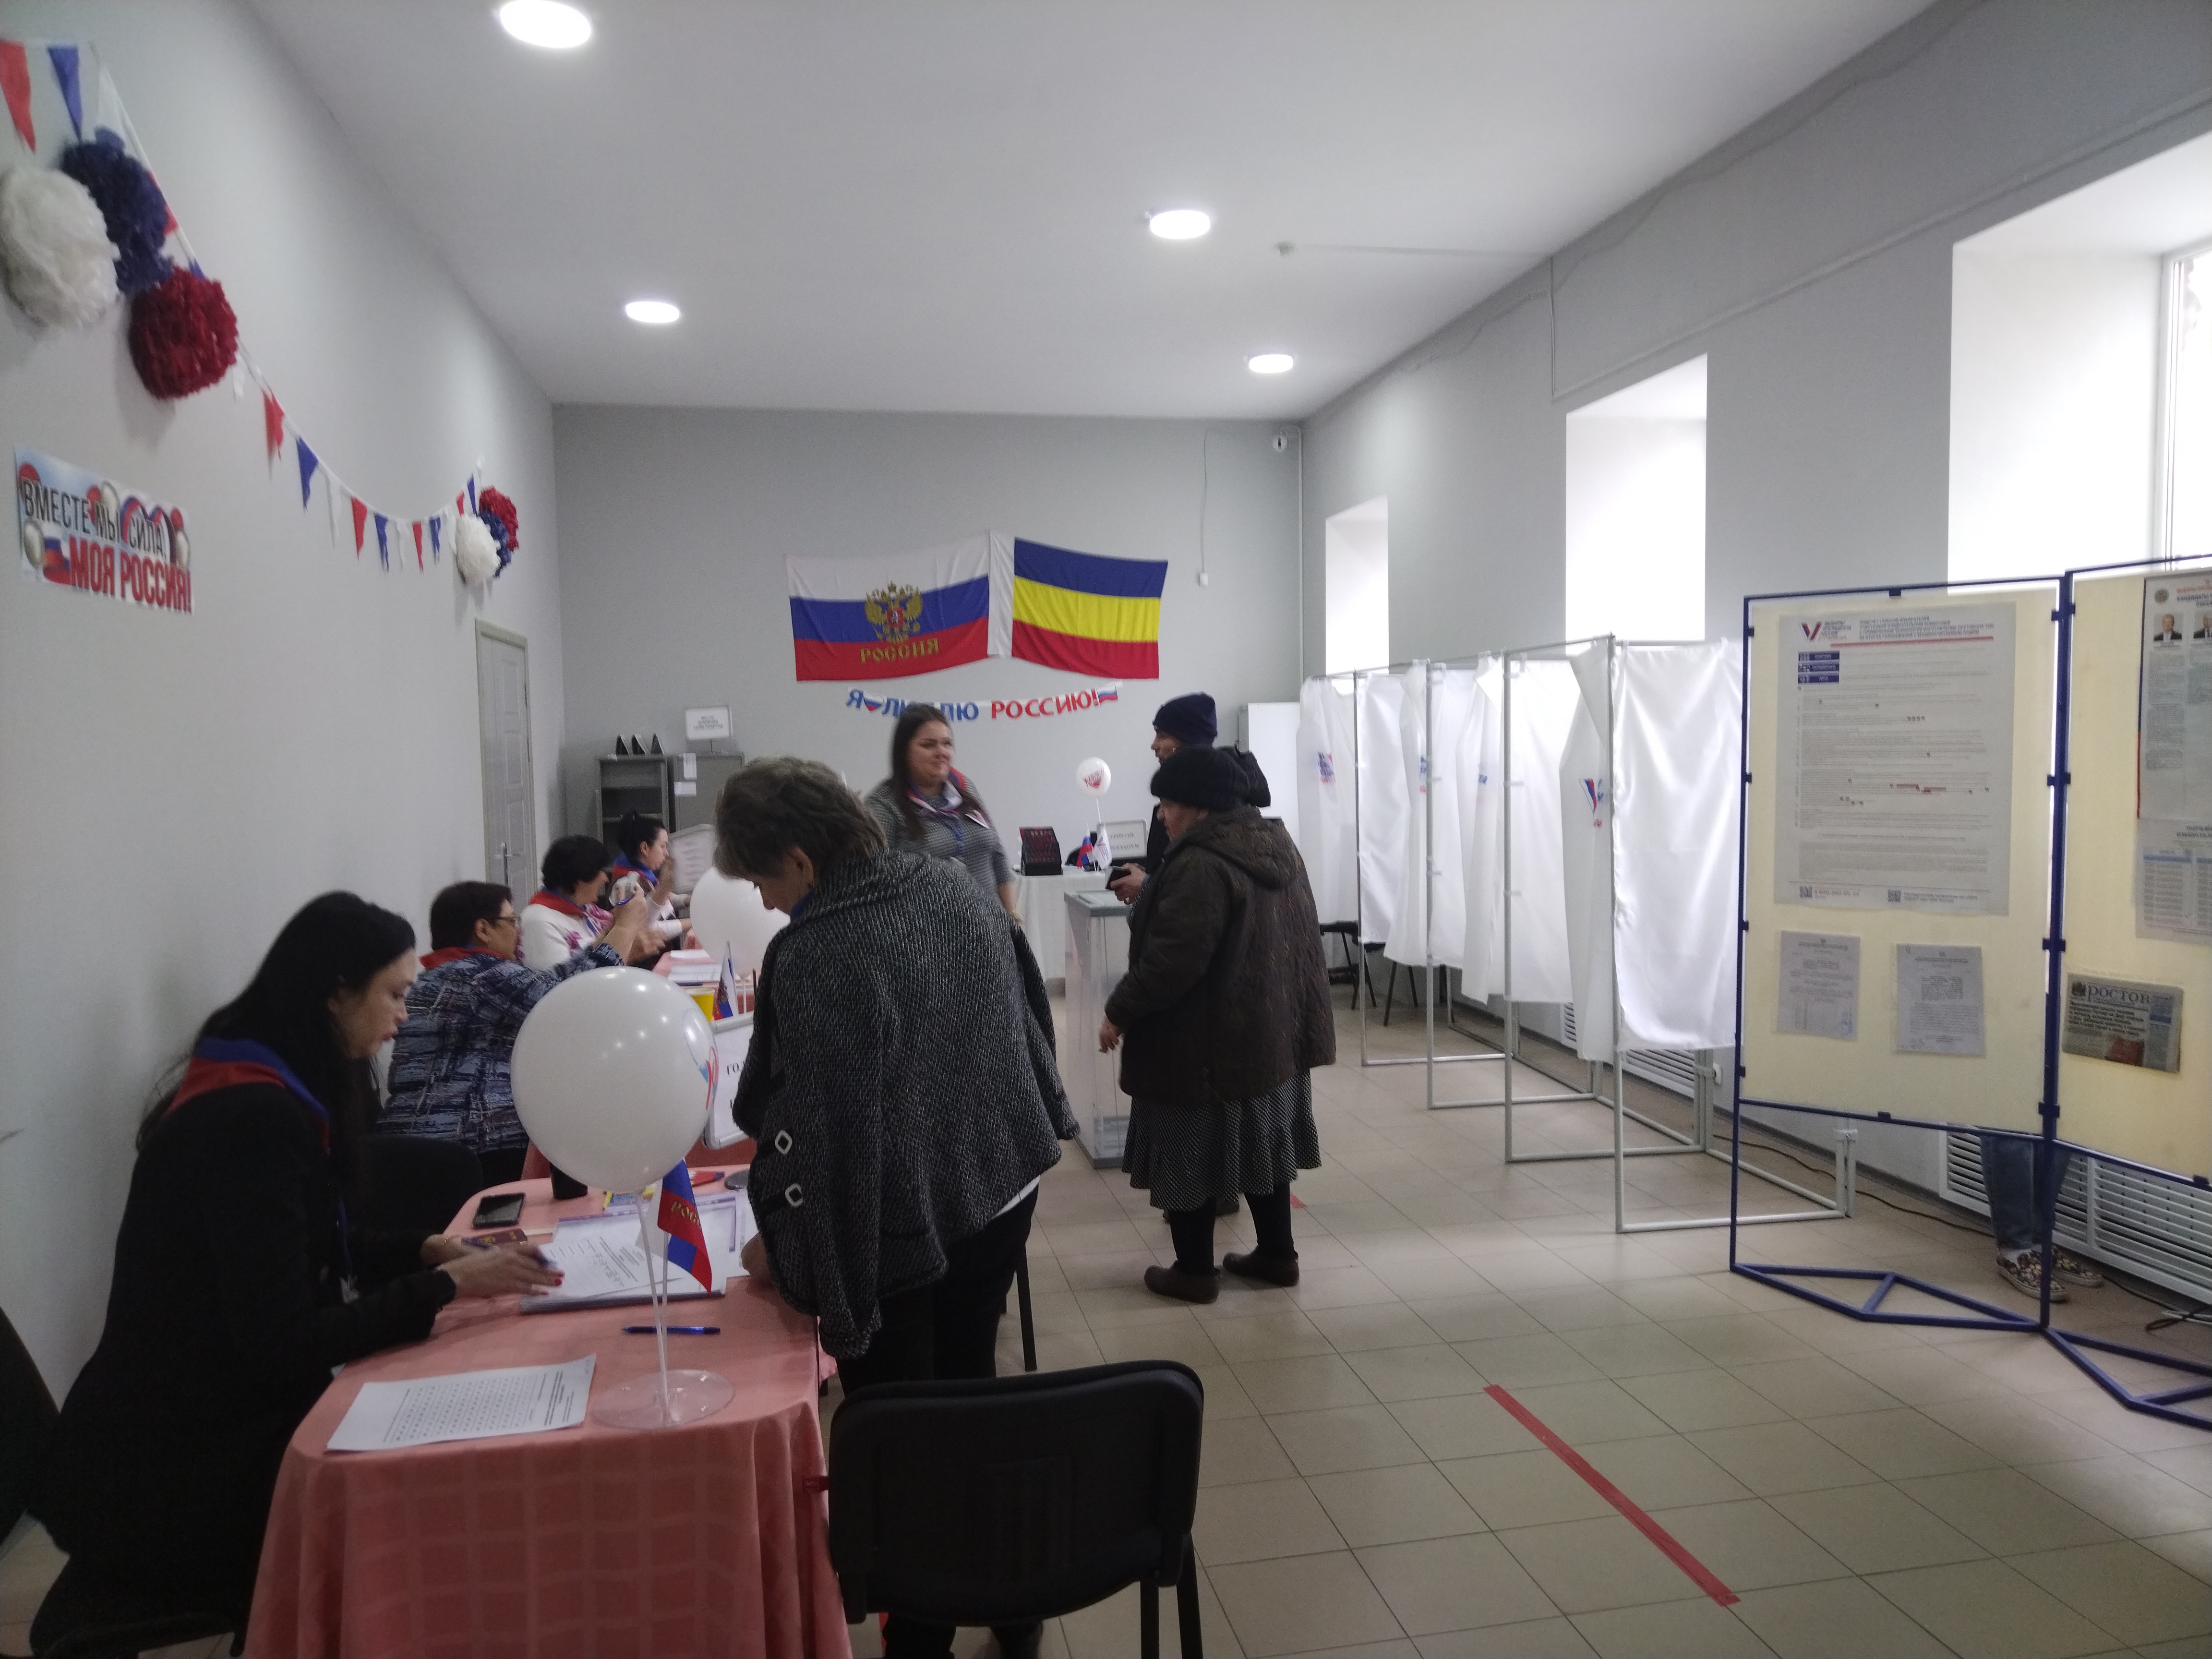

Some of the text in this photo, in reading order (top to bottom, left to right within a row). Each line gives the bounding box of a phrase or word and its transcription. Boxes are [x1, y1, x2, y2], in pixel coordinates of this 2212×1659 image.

[22, 478, 91, 534] ВМЕСТЕ
[96, 502, 121, 543] МЫ
[69, 535, 192, 614] МОЯ РОССИЯ!
[860, 637, 939, 663] РОССИЯ
[845, 688, 1099, 721] Я ЛЛЮ РОССИЮ!
